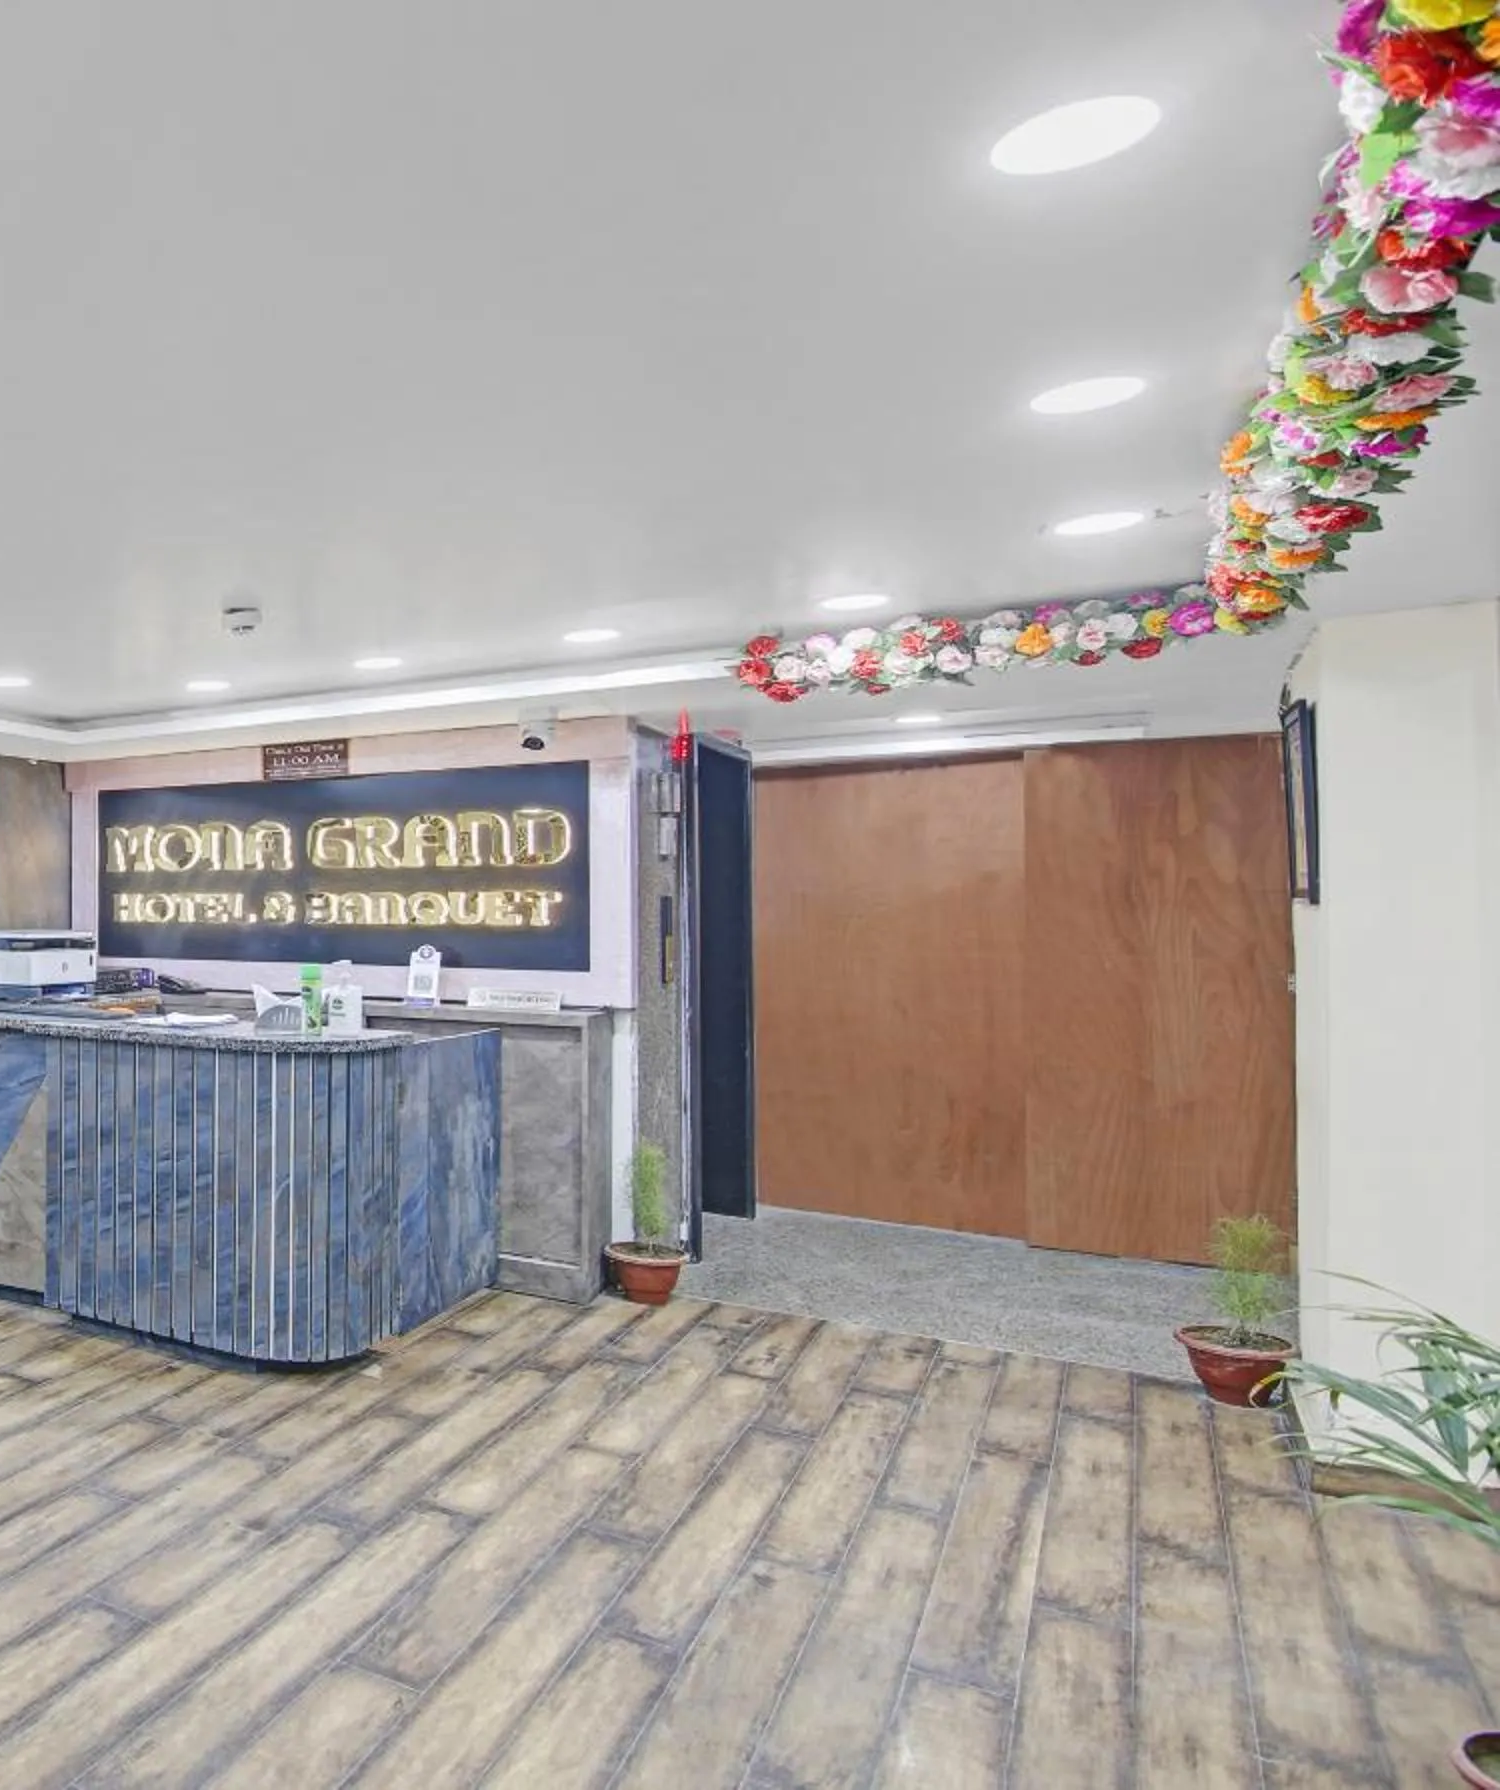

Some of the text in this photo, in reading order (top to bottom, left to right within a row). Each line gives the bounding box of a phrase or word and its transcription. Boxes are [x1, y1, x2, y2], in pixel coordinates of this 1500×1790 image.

[312, 752, 341, 765] AM
[105, 808, 571, 872] MONA GRAND
[113, 892, 257, 924] HOTEL
[304, 890, 563, 926] BANQUET
